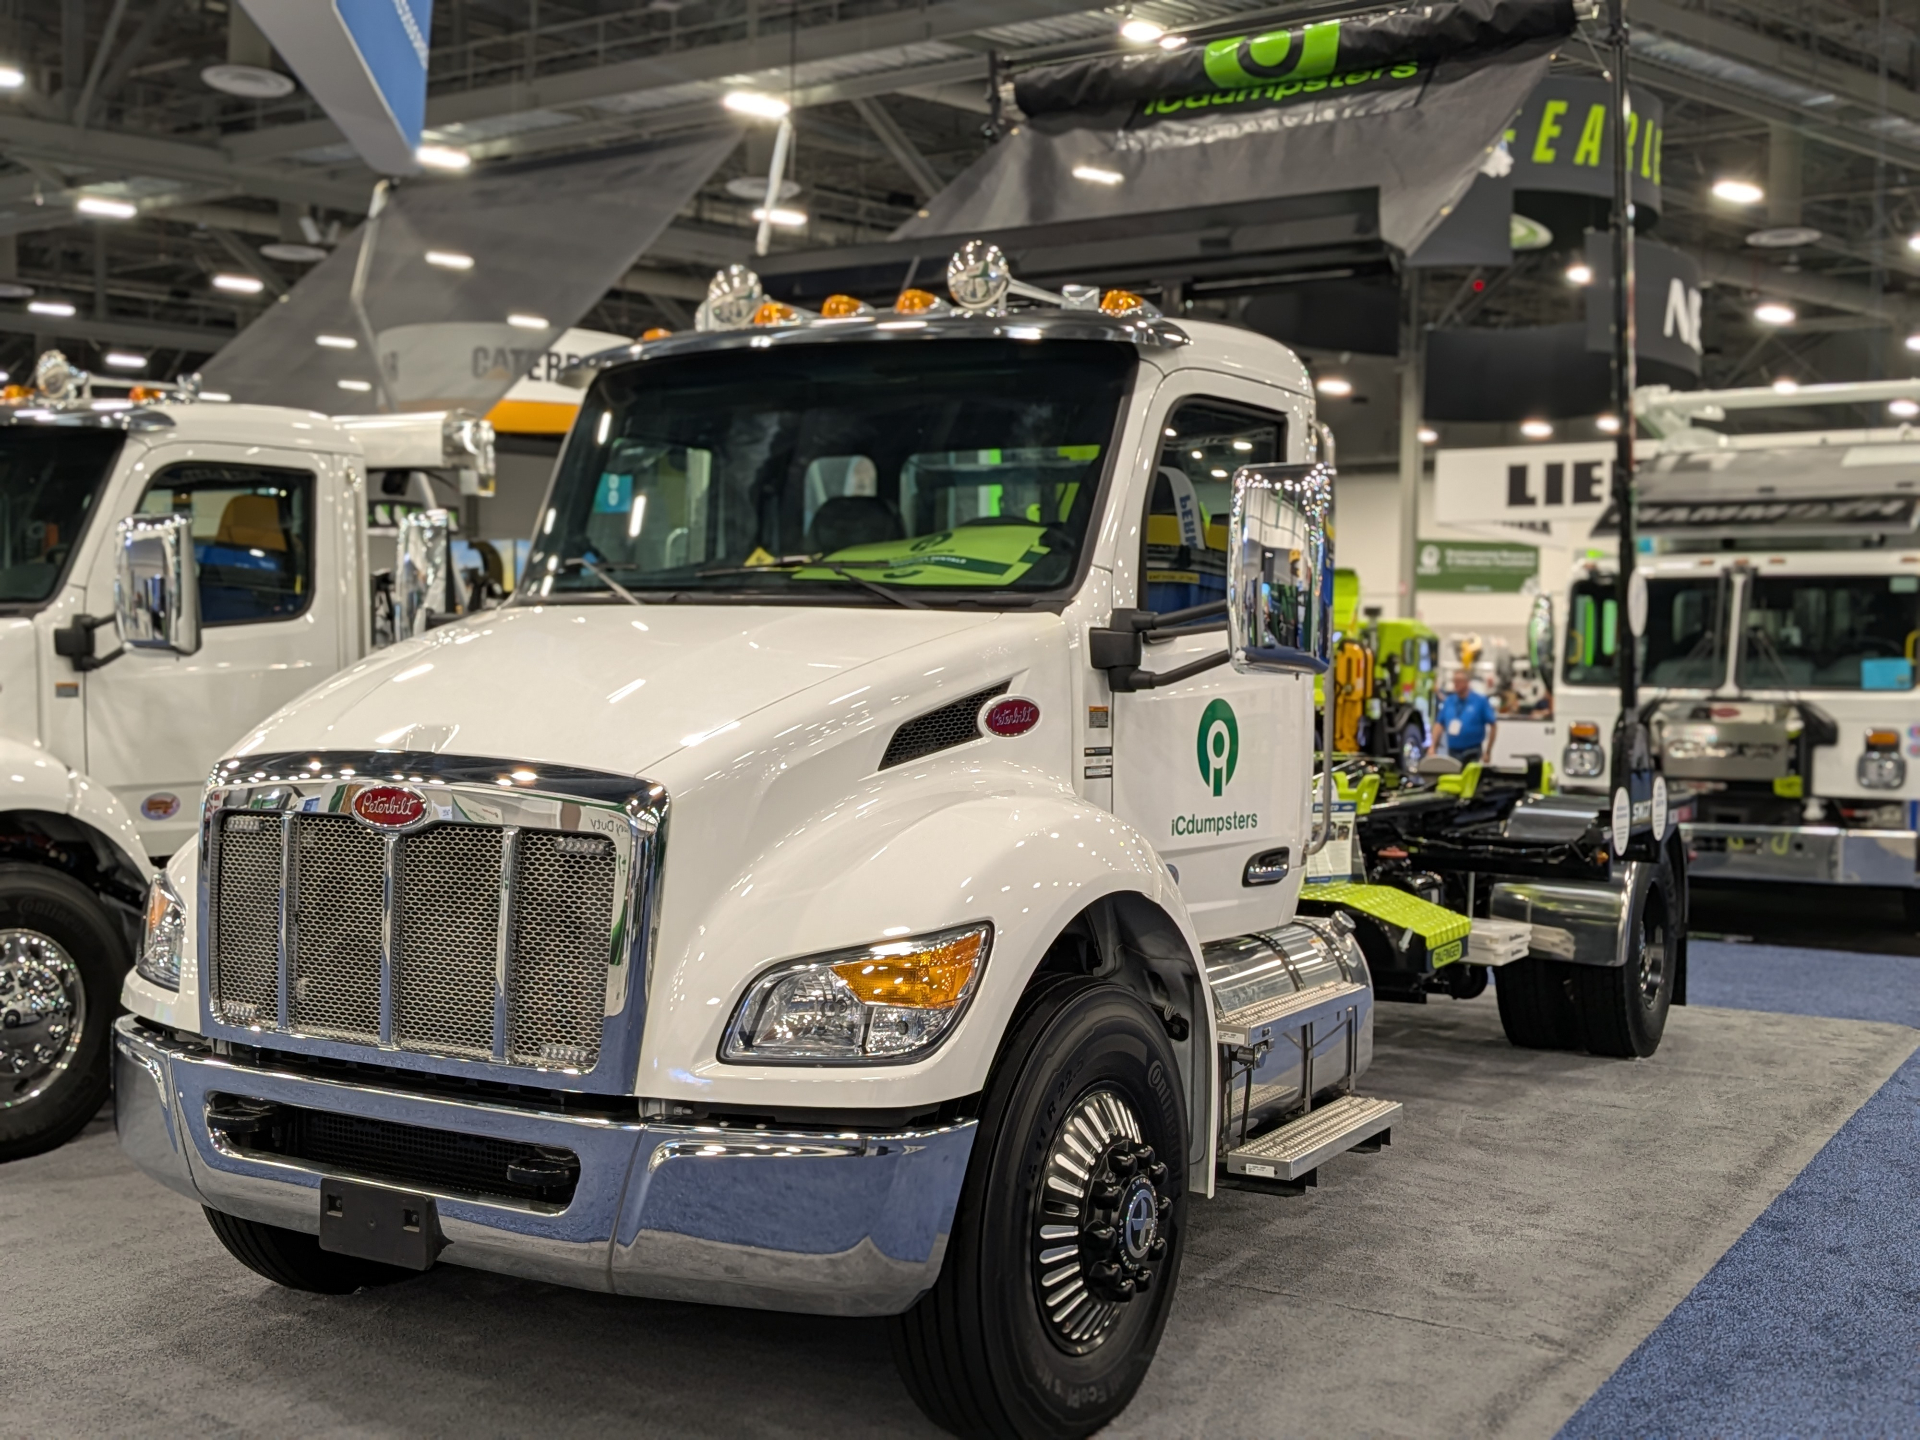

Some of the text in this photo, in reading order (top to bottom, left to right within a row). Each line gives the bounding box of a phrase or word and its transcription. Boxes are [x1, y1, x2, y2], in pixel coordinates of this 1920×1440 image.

[1507, 461, 1617, 506] LIE
[992, 706, 1035, 728] Peterbilt
[361, 793, 418, 815] Peterbilt
[1171, 811, 1258, 836] iCdumpsters
